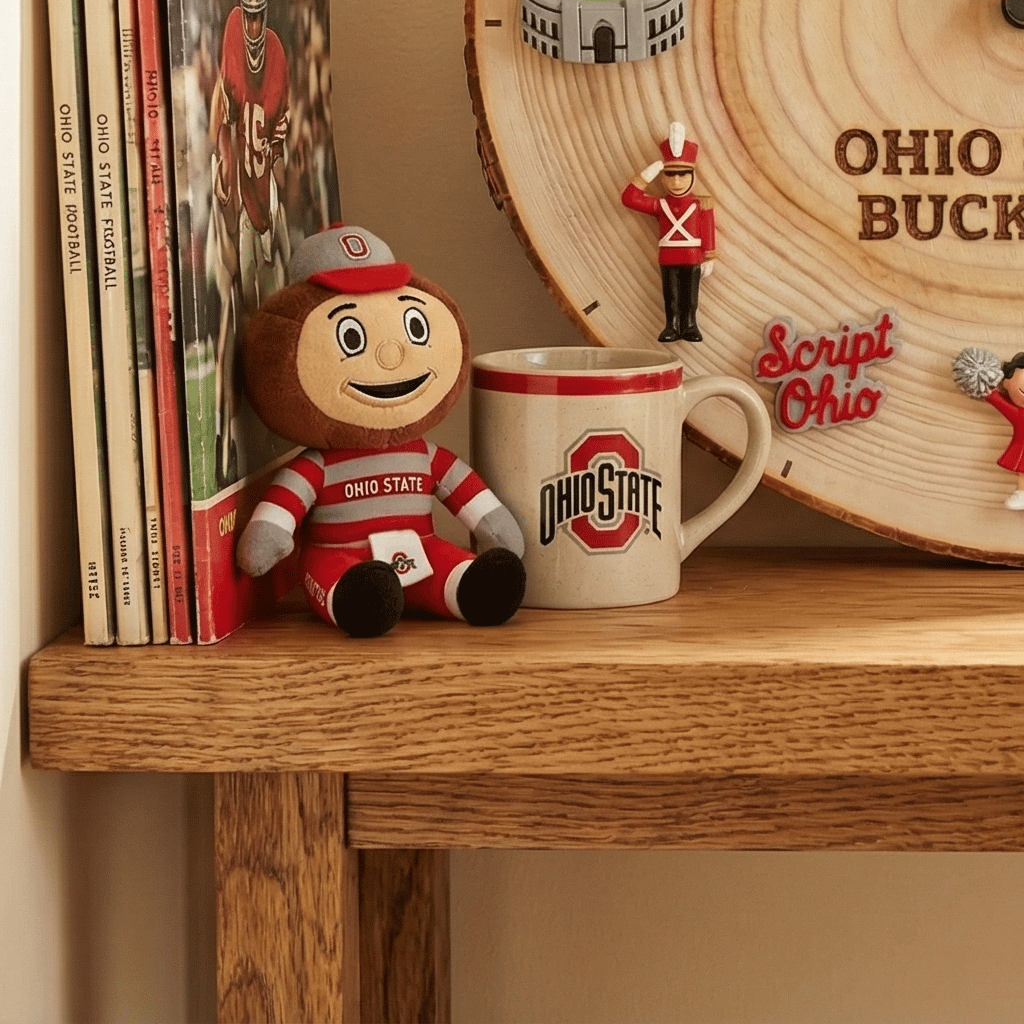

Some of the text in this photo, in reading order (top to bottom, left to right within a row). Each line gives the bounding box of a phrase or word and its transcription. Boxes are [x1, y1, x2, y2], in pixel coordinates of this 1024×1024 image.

[59, 104, 72, 143] OHIO
[97, 114, 110, 154] OHIO
[62, 152, 76, 194] STATE
[834, 128, 1002, 176] OHIO
[99, 163, 113, 209] STATE
[756, 314, 894, 380] Script
[780, 373, 883, 429] Ohio
[345, 476, 423, 498] OHIO STATE
